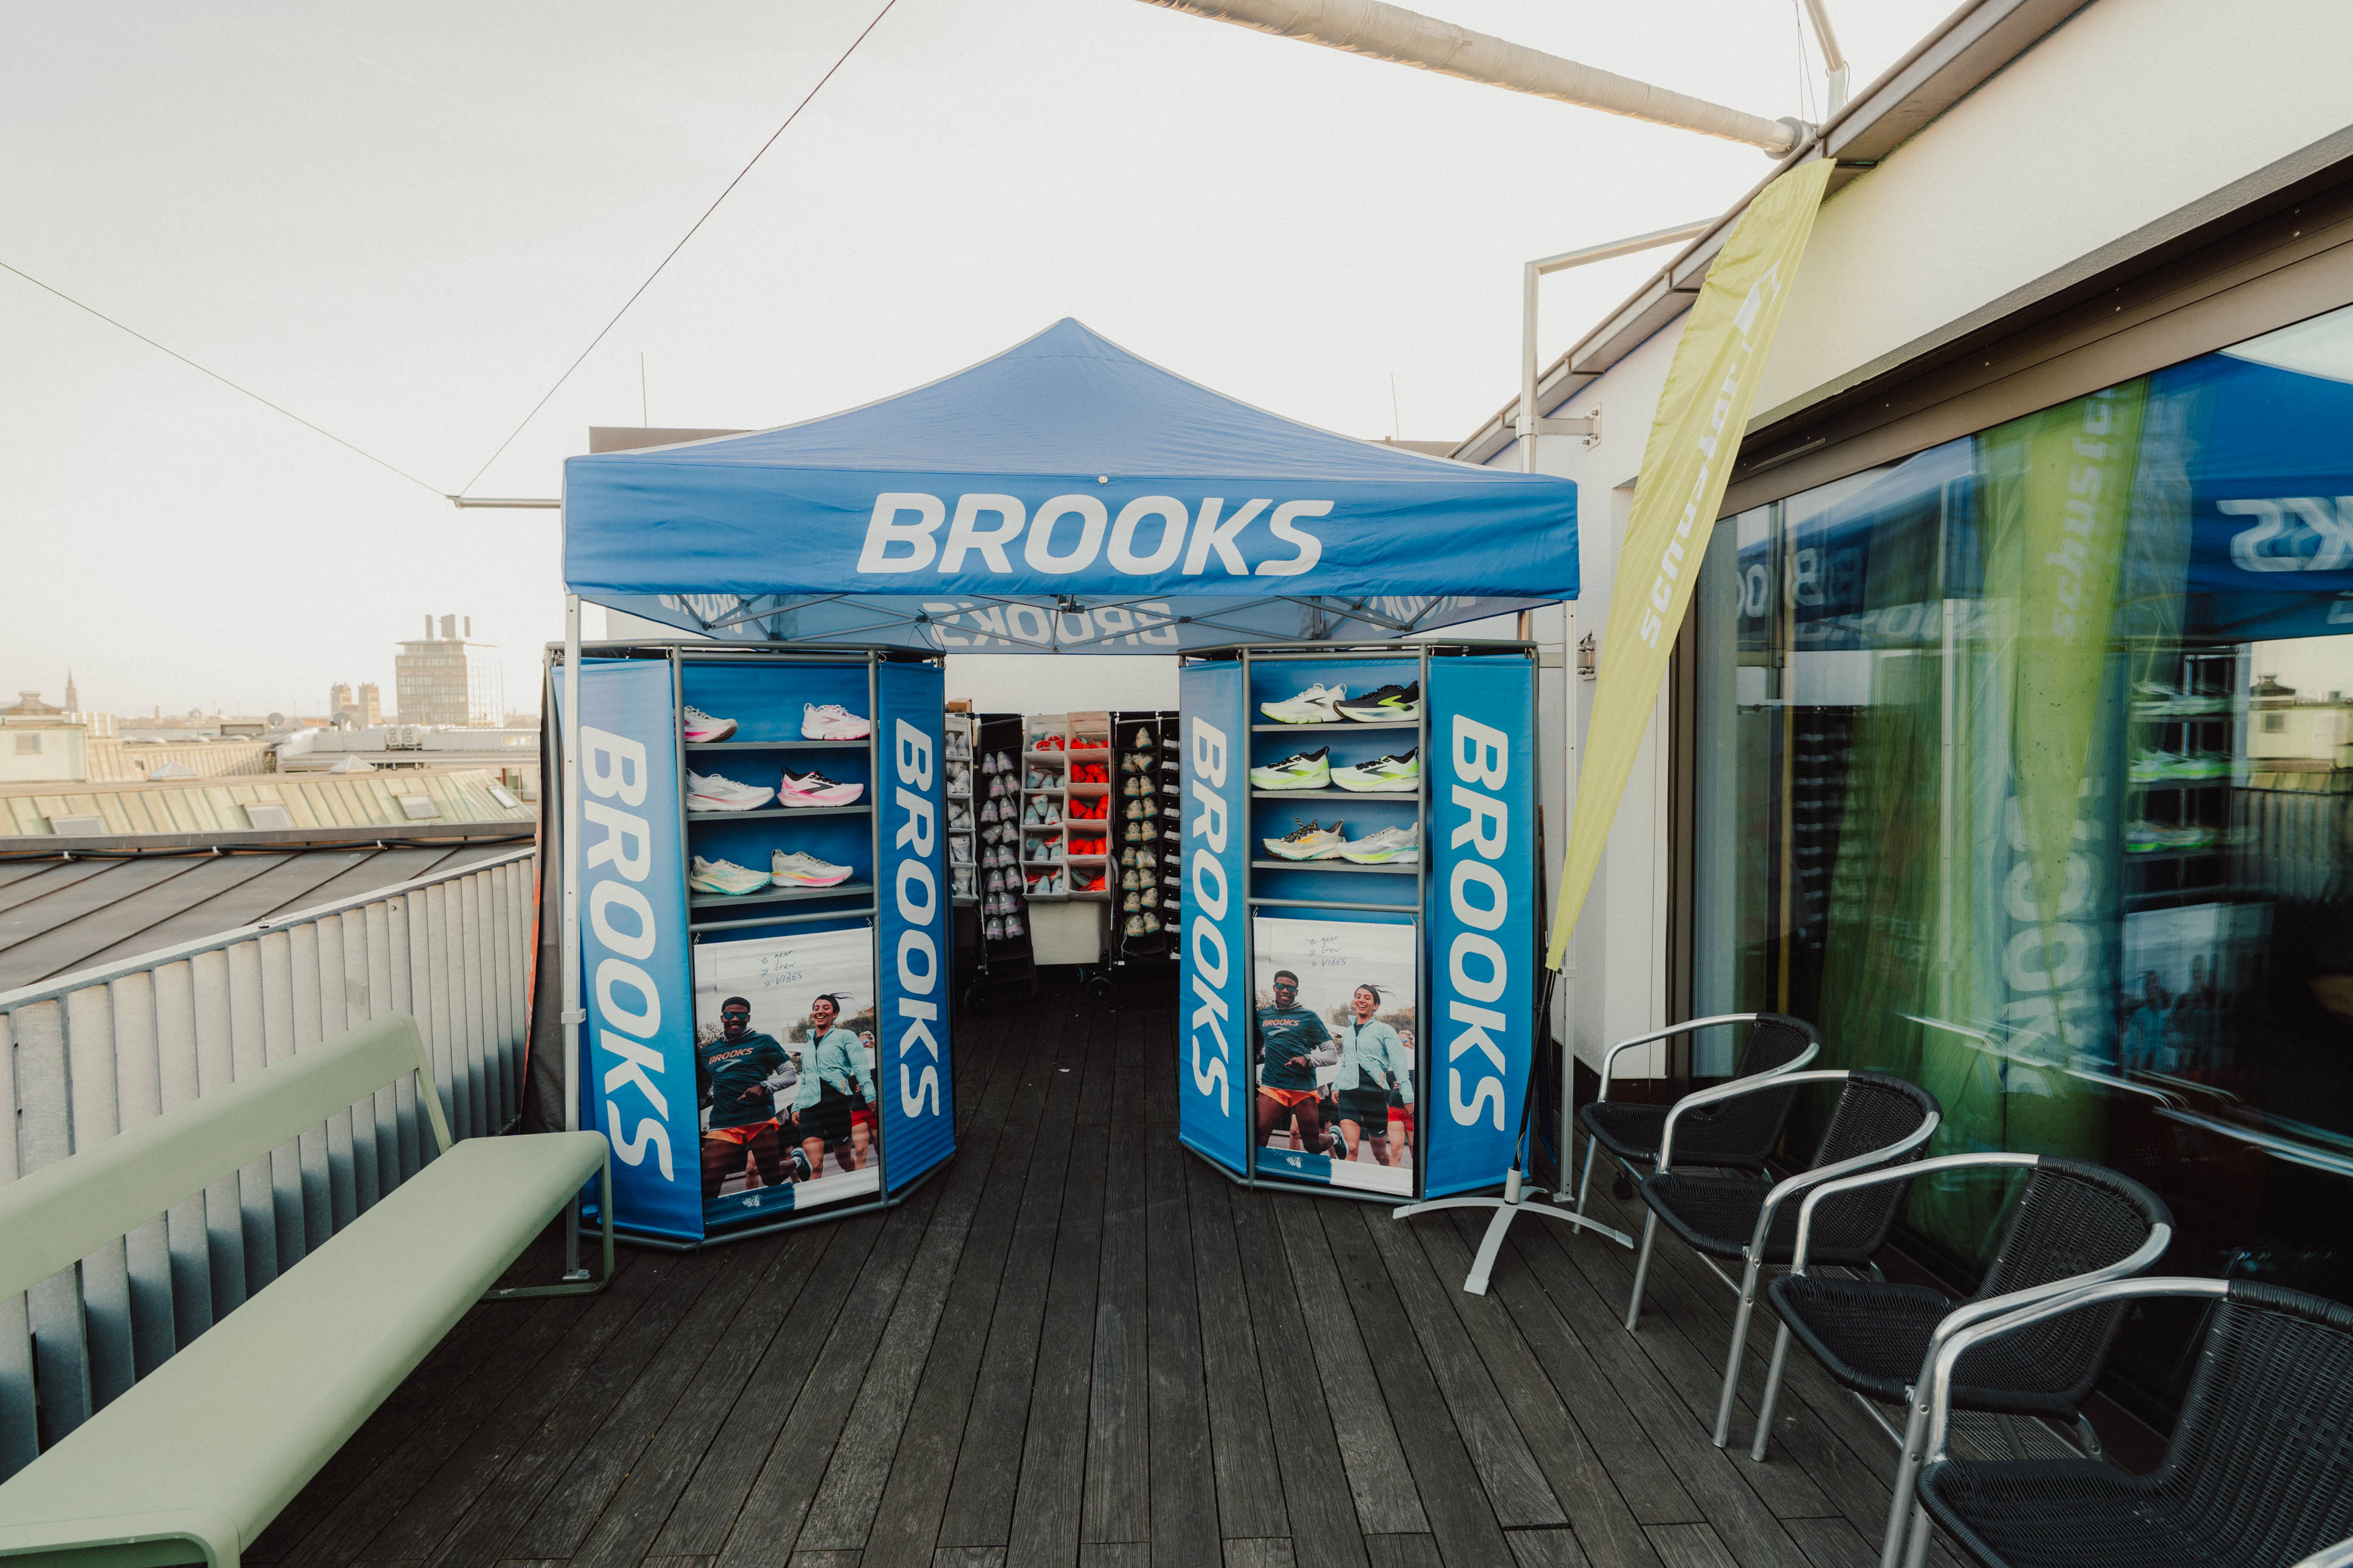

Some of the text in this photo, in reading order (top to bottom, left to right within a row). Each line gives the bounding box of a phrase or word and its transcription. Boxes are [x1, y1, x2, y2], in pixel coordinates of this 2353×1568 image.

[856, 492, 1335, 576] BROOKS
[895, 717, 940, 1118] BROOKS
[1192, 716, 1229, 1118] BROOKS
[1321, 936, 1338, 947] gear
[1448, 714, 1509, 1132] BROOKS
[580, 725, 675, 1182] BROOKS
[773, 950, 794, 967] gear
[775, 960, 797, 971] crew
[775, 971, 803, 985] VIBES
[709, 1047, 754, 1064] BROOKS
